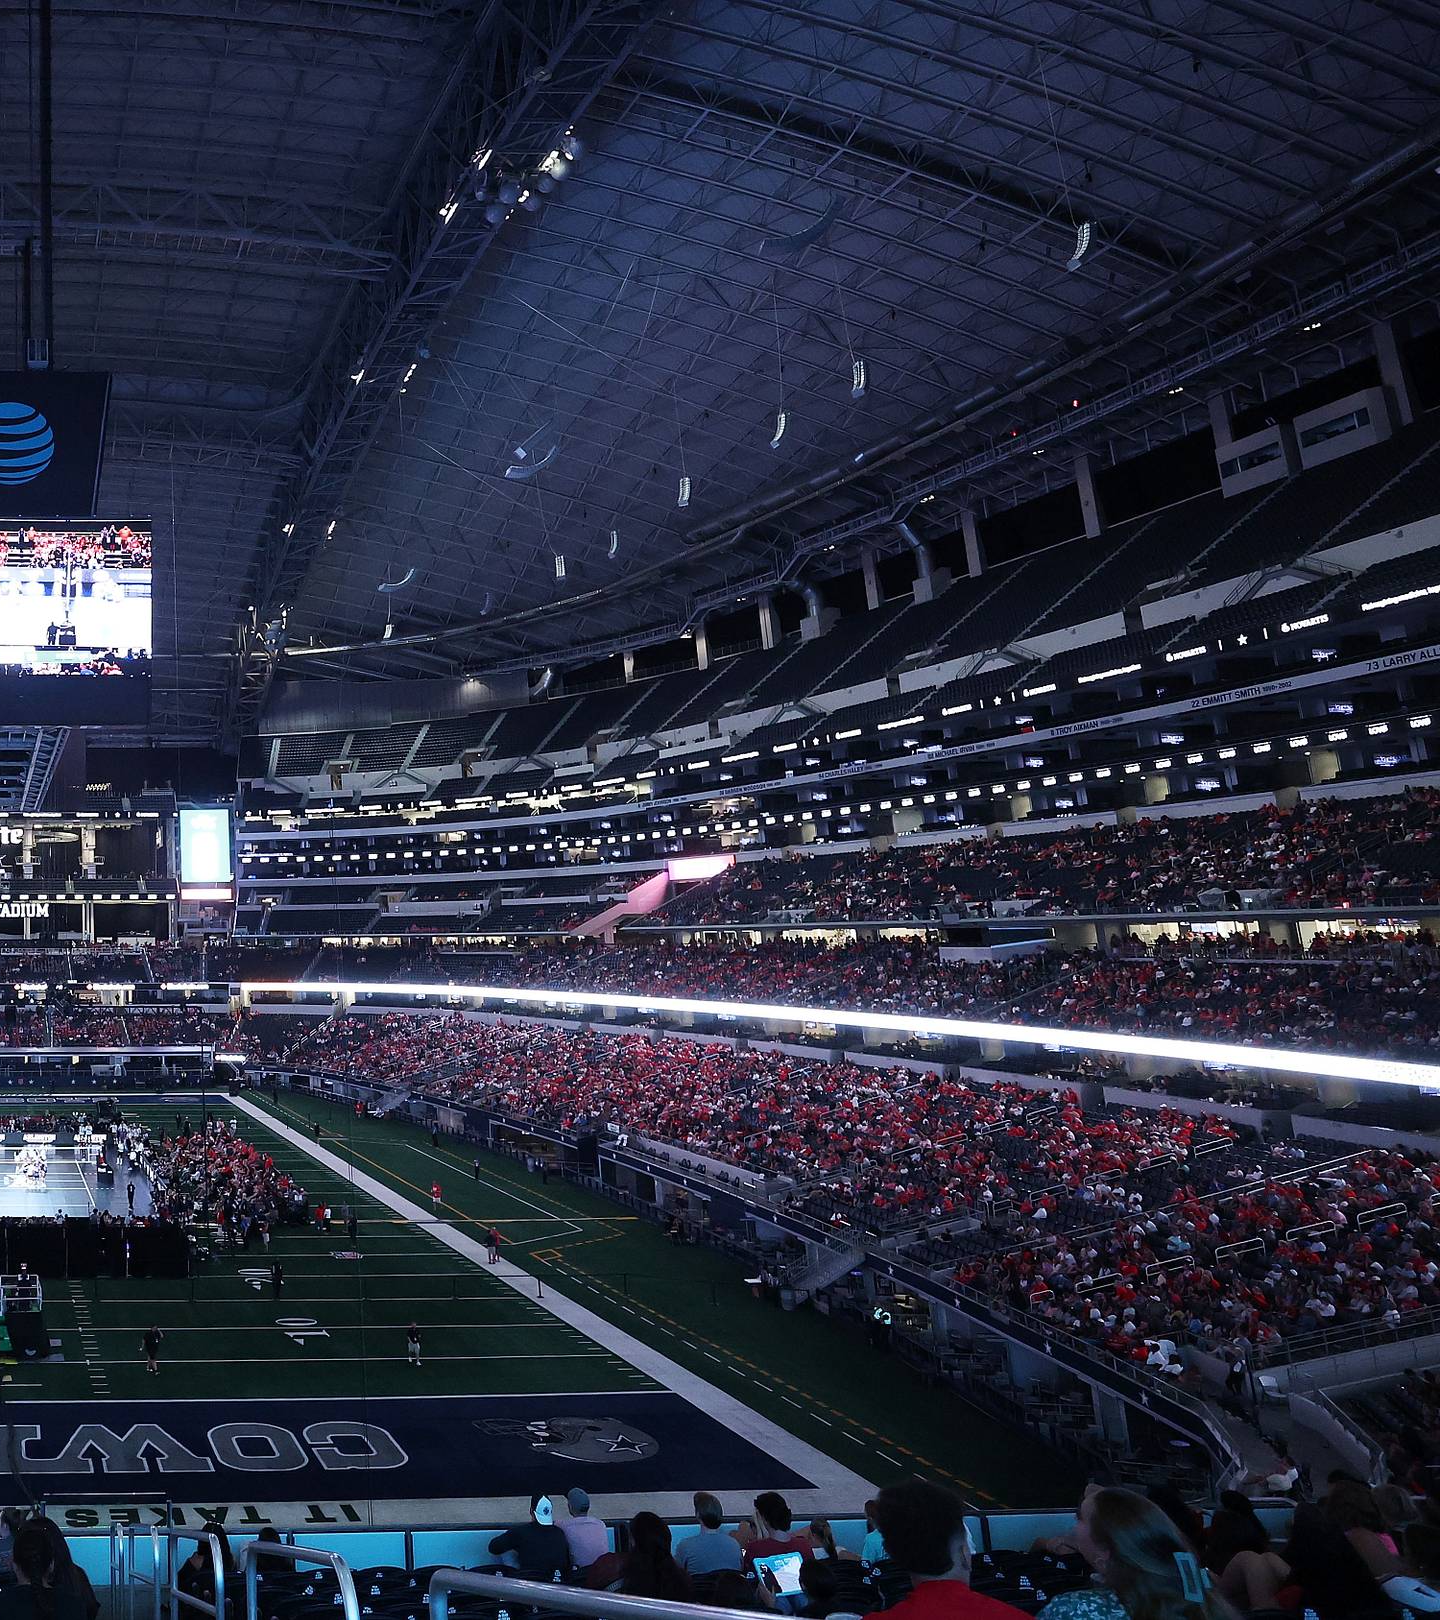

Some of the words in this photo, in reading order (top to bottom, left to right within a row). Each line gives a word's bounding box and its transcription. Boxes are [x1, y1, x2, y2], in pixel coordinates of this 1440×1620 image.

[1366, 661, 1379, 671] 73
[1383, 652, 1416, 667] LARRY
[1191, 699, 1201, 708] 22
[1202, 693, 1232, 706] EMMITT
[1234, 686, 1261, 700] SMITH
[1073, 720, 1099, 732] AIKMAN
[64, 1504, 272, 1529] TAKES
[304, 1503, 362, 1524] IT
